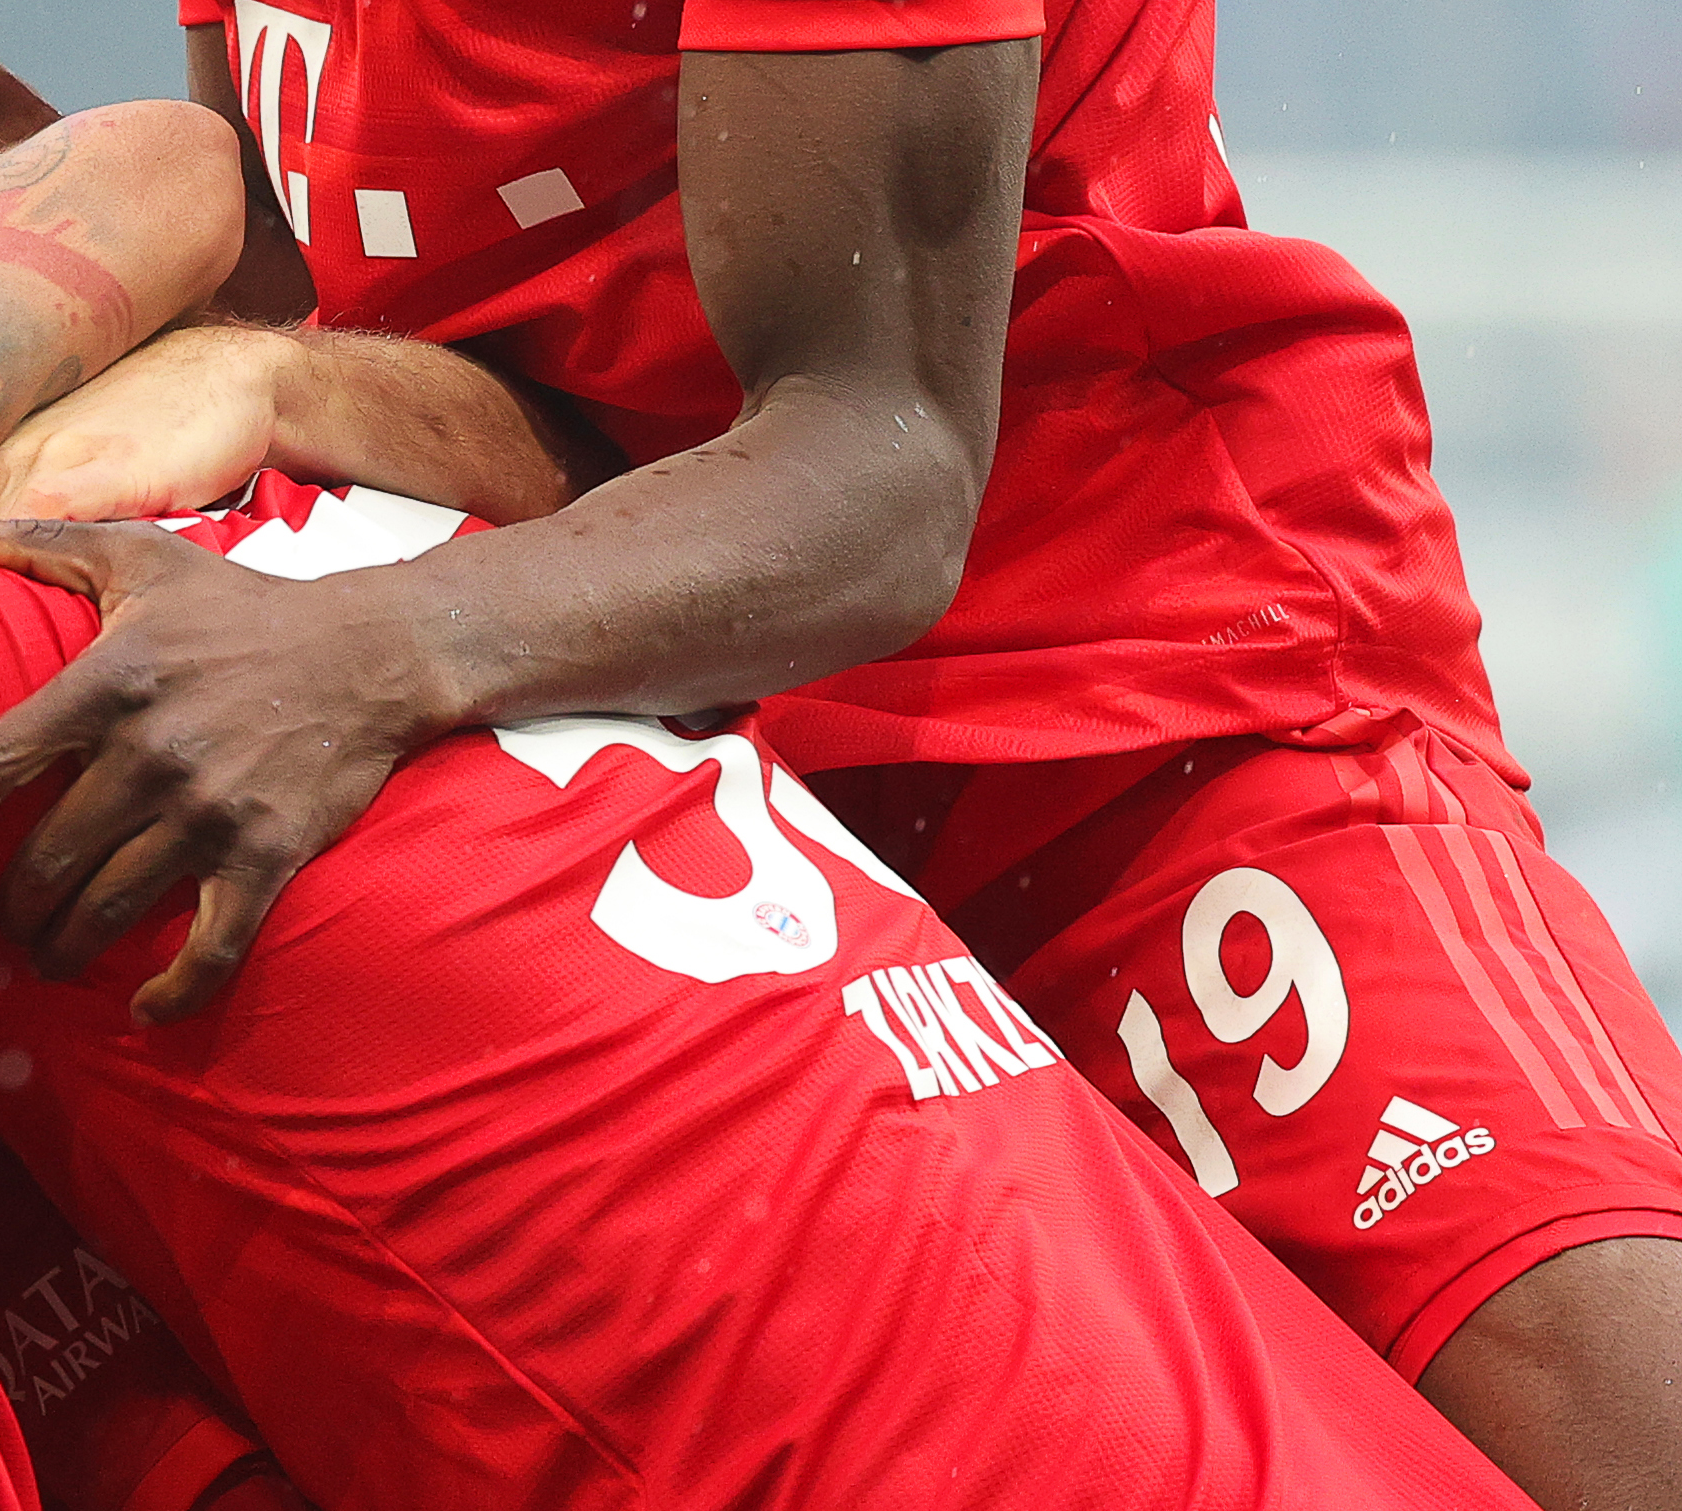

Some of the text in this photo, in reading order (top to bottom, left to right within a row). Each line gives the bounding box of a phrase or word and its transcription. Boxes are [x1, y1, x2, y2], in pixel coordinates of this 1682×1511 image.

[1201, 603, 1290, 646] MACHILL
[1117, 866, 1350, 1198] 19
[1352, 1125, 1496, 1230] adidas
